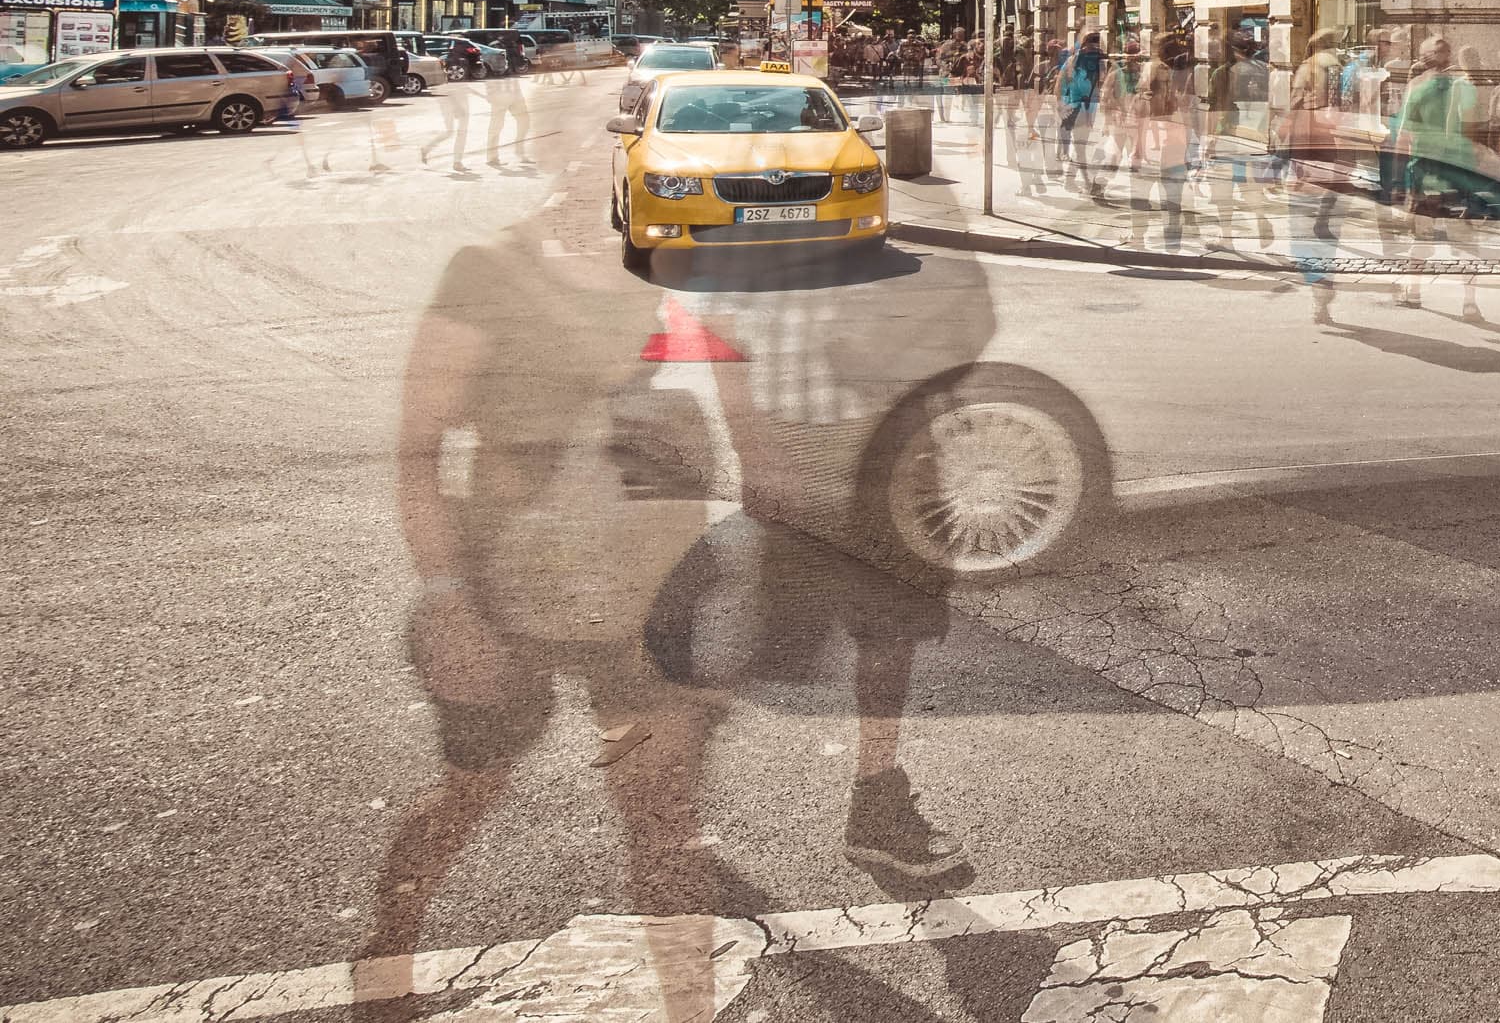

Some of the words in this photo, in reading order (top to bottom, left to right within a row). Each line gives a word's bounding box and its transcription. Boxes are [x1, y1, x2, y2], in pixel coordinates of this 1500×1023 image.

[765, 62, 790, 71] TAXI
[746, 208, 770, 221] 2SZ
[779, 207, 810, 219] 4678
